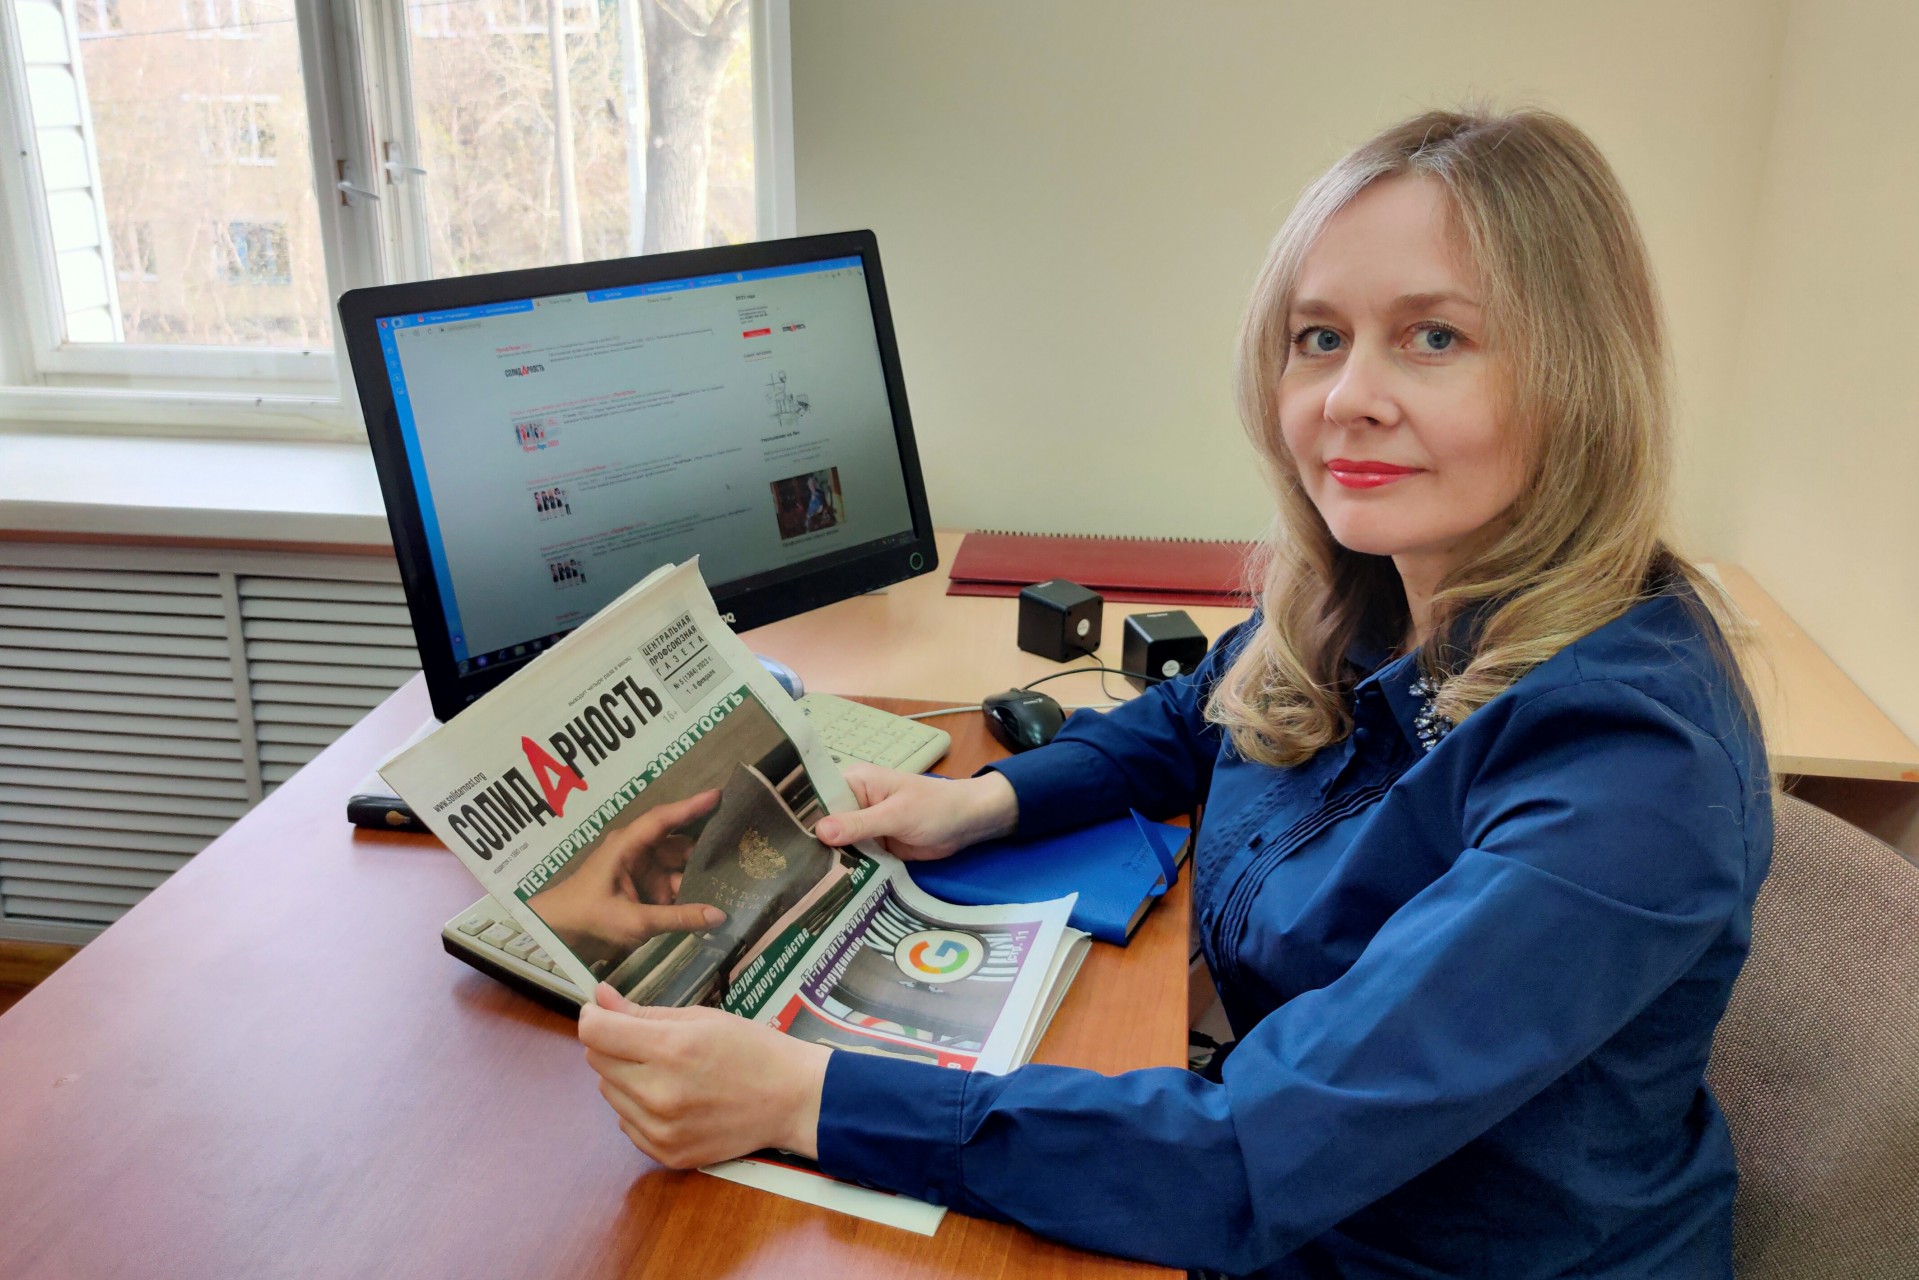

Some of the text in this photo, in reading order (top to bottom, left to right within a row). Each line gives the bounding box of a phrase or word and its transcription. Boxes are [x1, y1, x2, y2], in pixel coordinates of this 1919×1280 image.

[641, 614, 692, 657] ЦЕНТРАЛЬНАЯ
[648, 624, 698, 667] ПРОФСОЮЗНАЯ
[696, 658, 710, 671] 2023
[696, 669, 716, 687] февраля
[662, 710, 678, 723] 16+
[447, 674, 664, 862] СОЛИДАРНОСТЬ
[433, 771, 488, 813] www.solidarnost.org
[516, 692, 745, 898] ПЕРЕПРИДУМАТЬ ЗАНЯТОСТЬ
[849, 858, 871, 885] стр. 6
[800, 878, 889, 988] IT-гиганты сокращают
[1015, 930, 1030, 941] 11
[725, 953, 766, 1006] обсудили
[741, 927, 811, 1011] трудоустройстве
[814, 936, 864, 999] сотрудников
